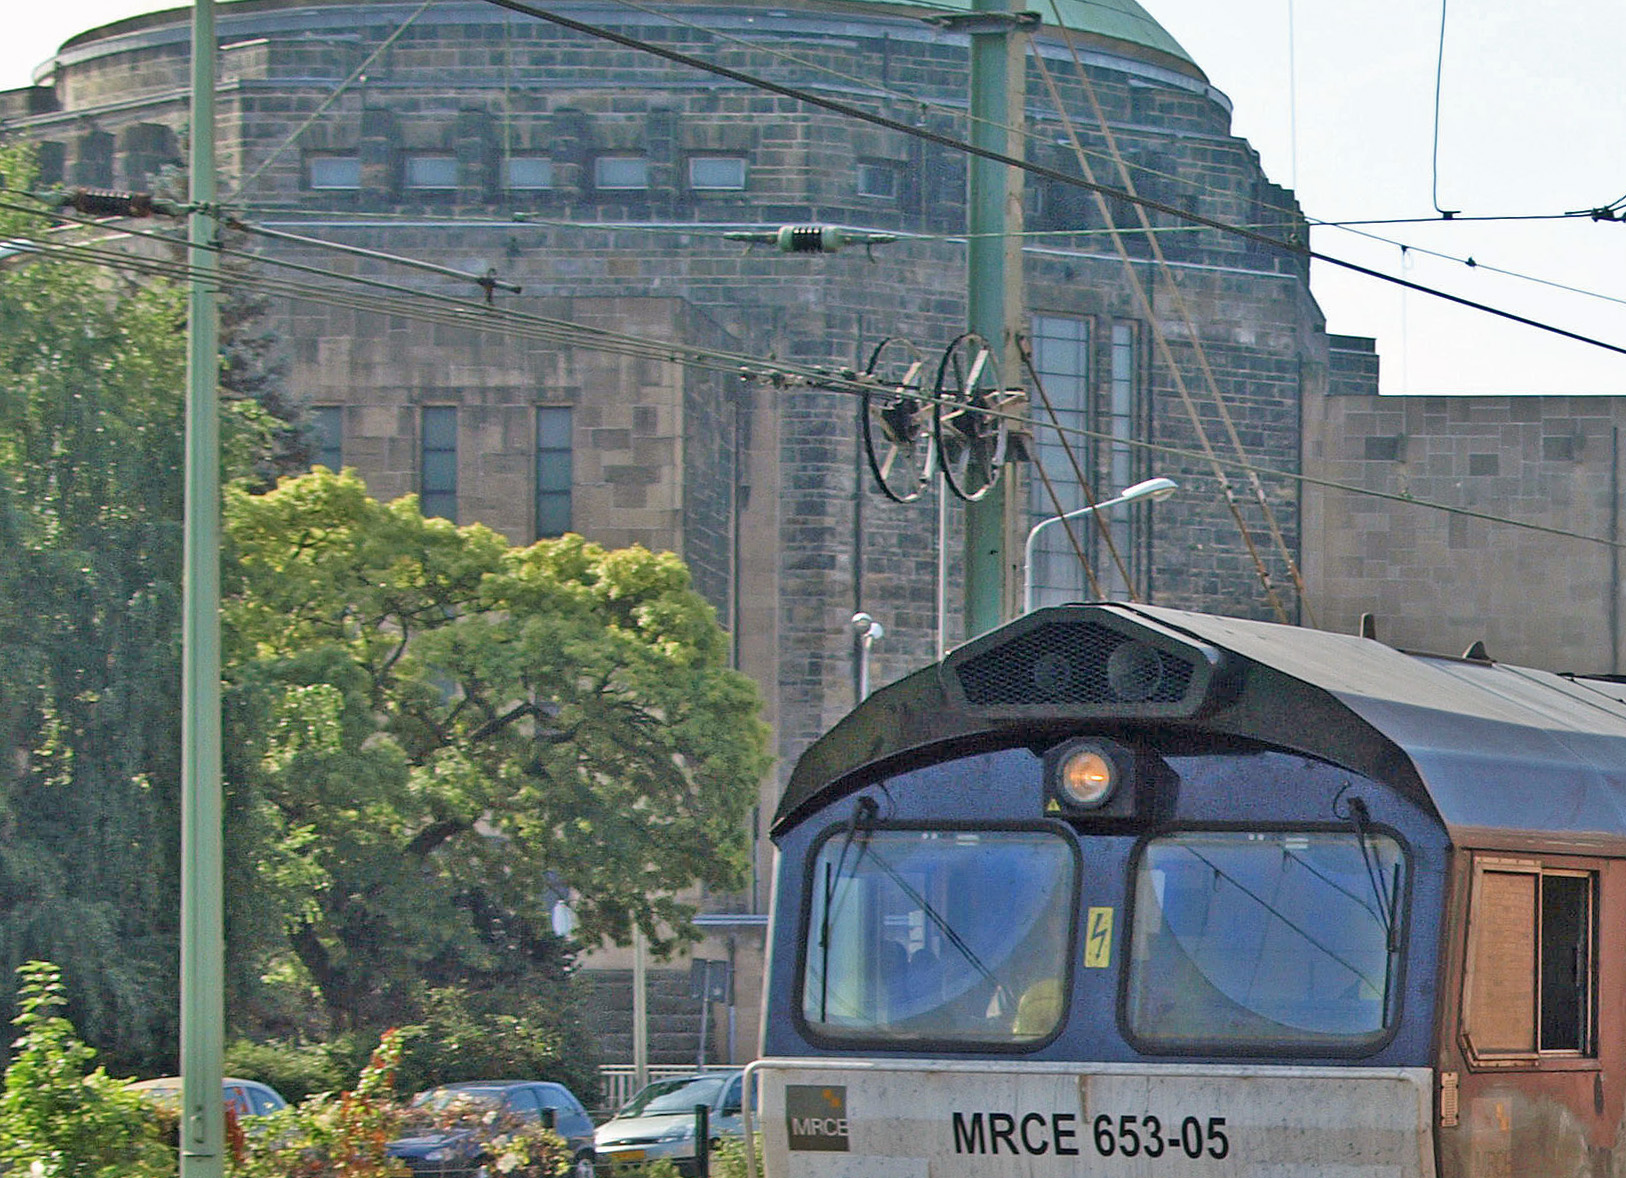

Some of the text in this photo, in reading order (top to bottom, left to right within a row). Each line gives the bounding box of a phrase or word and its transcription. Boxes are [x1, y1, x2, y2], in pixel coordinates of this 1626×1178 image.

[792, 1117, 849, 1136] MRCE
[953, 1111, 1229, 1160] MRCE 653-05
